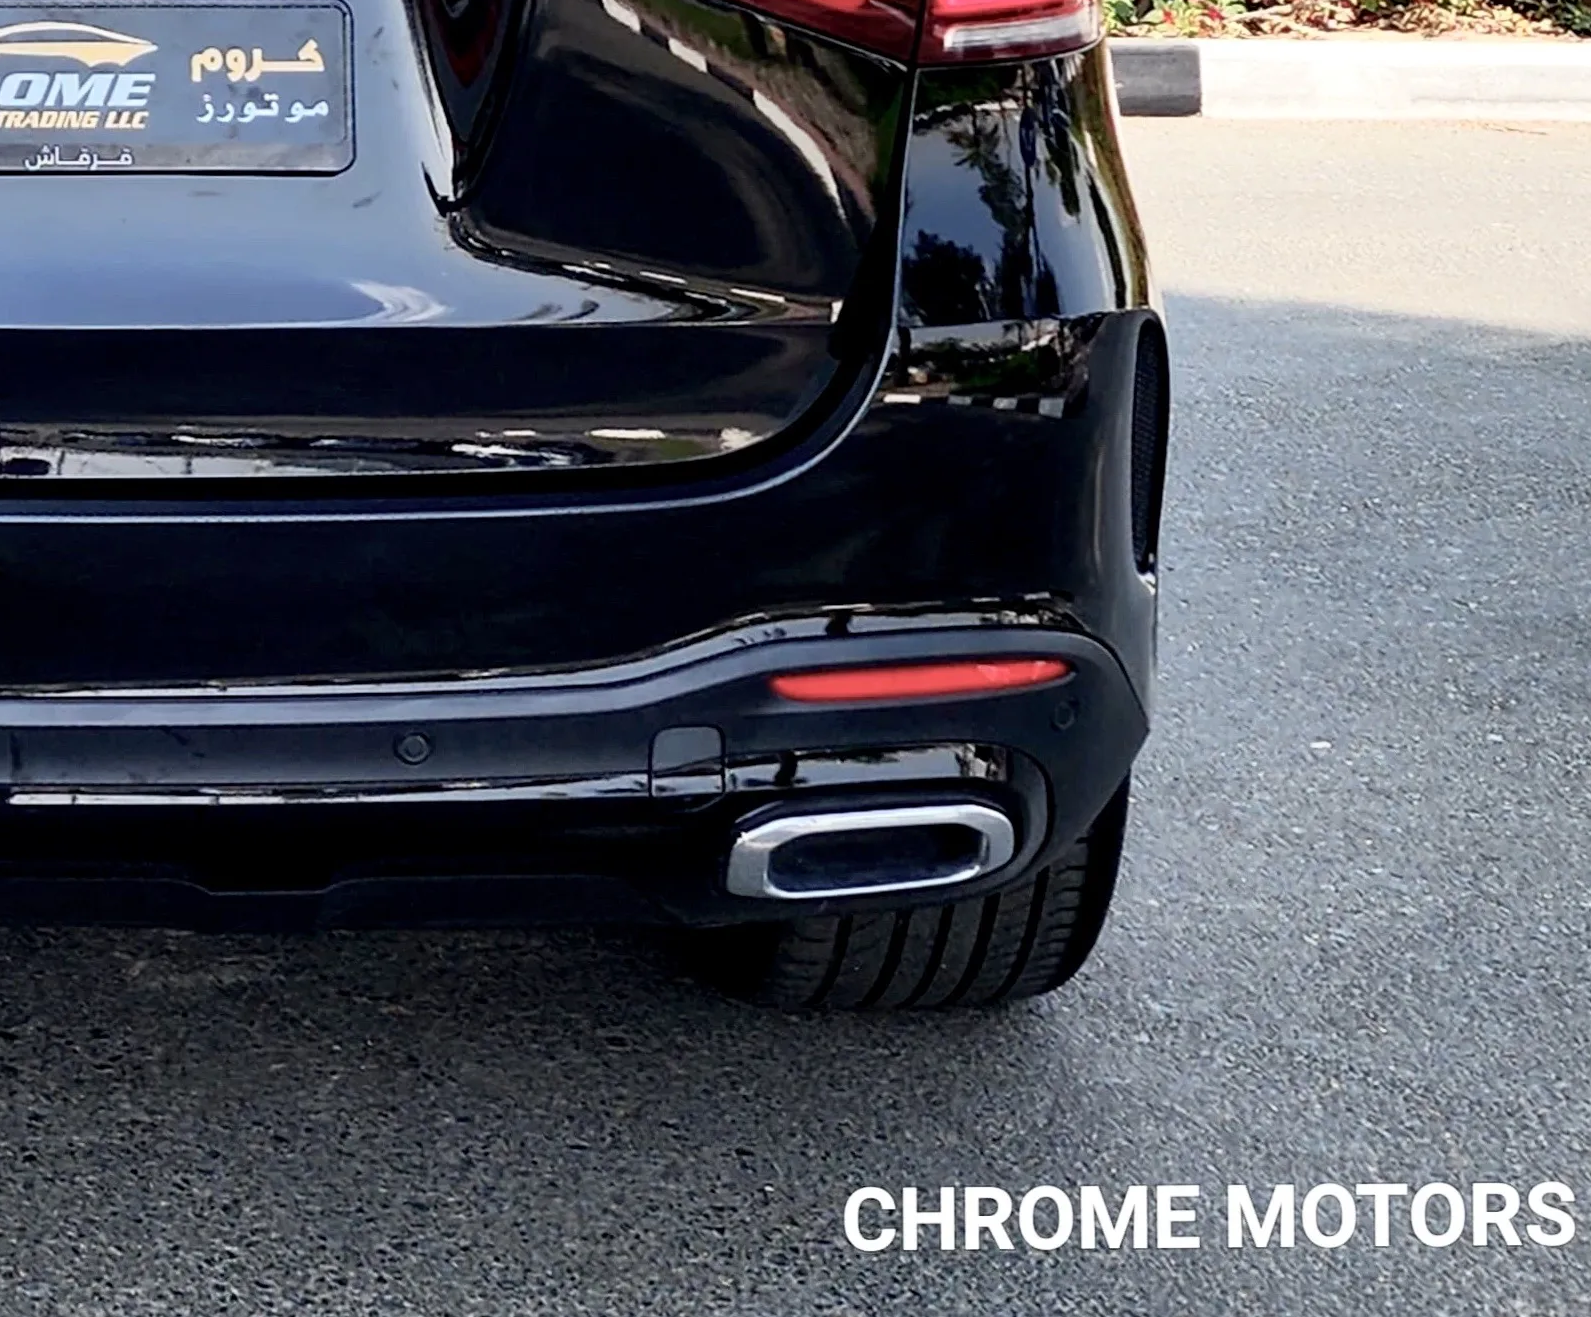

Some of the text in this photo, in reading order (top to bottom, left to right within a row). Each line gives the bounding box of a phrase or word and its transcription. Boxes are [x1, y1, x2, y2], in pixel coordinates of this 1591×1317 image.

[190, 38, 325, 82] كروم
[104, 111, 150, 130] LLC
[24, 145, 133, 171] قرقاش
